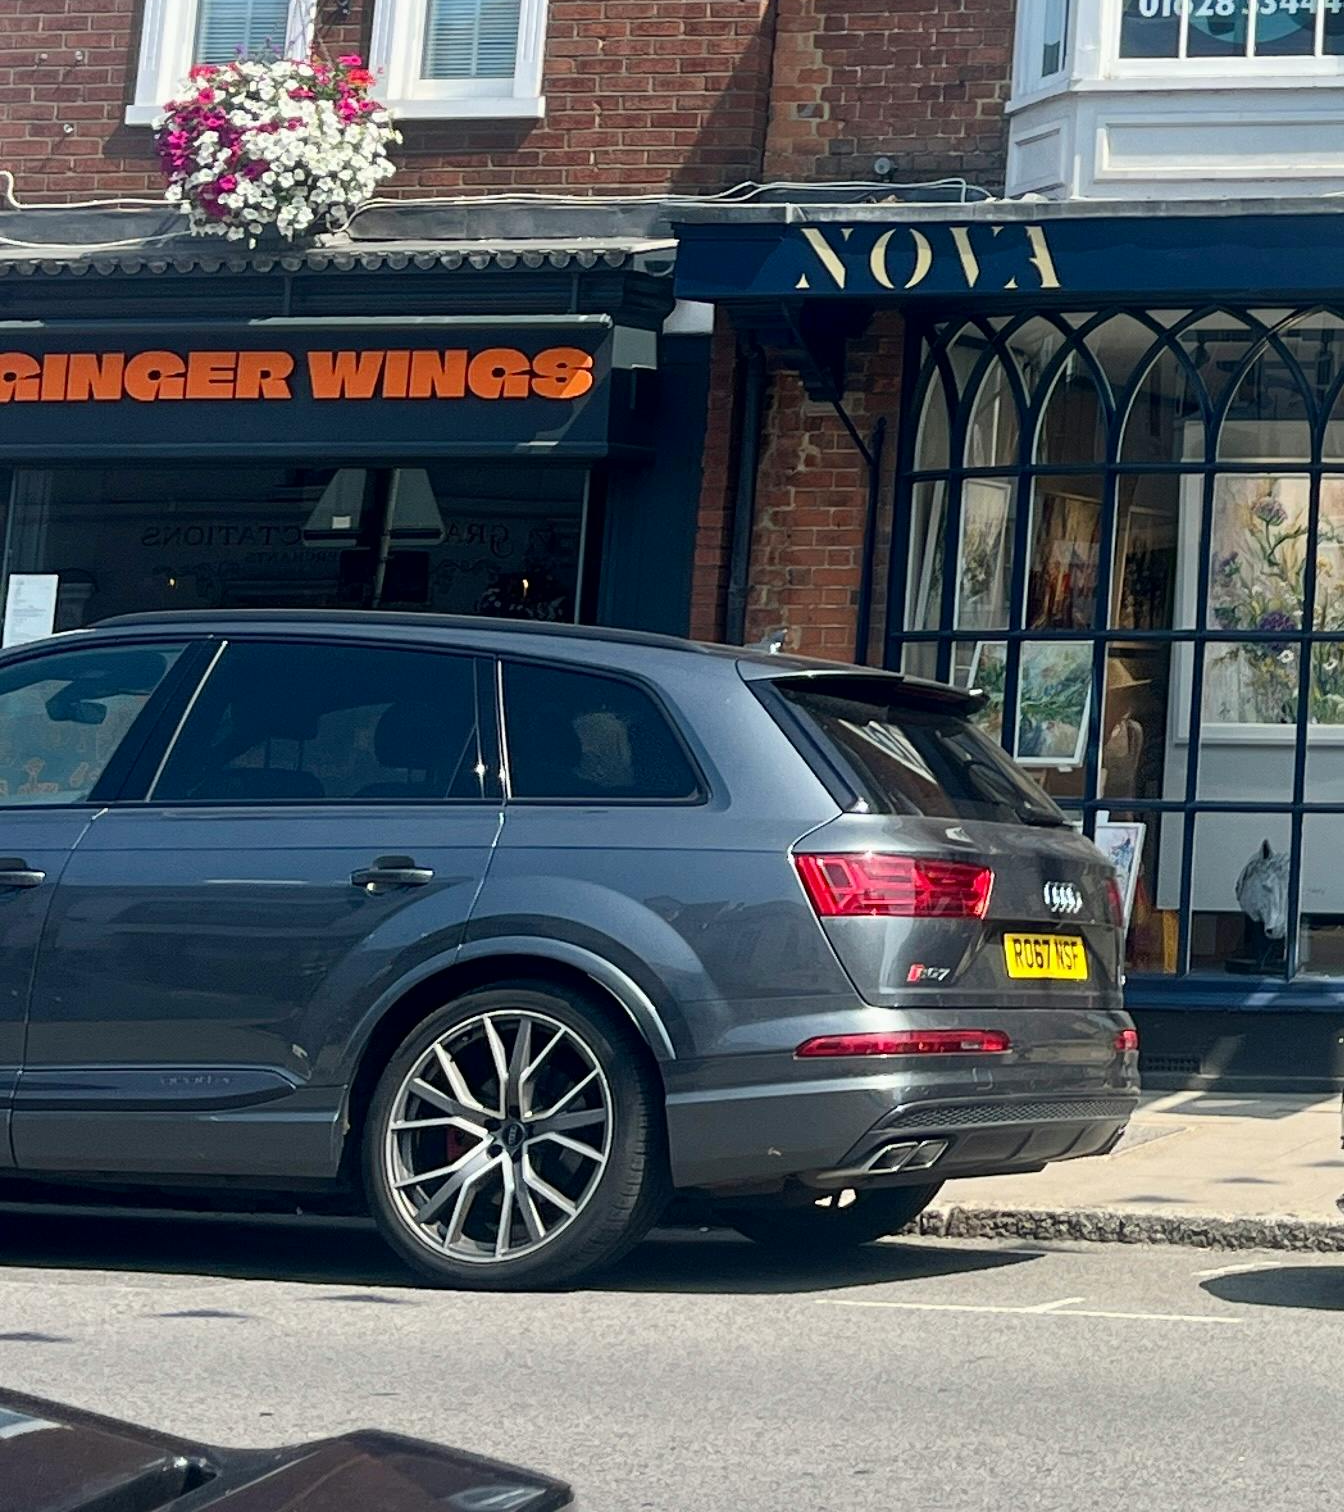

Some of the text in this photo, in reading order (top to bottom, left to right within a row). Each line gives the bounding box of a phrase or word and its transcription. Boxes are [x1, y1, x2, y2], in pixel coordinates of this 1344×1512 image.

[795, 226, 1062, 289] NOVA
[0, 347, 593, 402] GINGER WINGS
